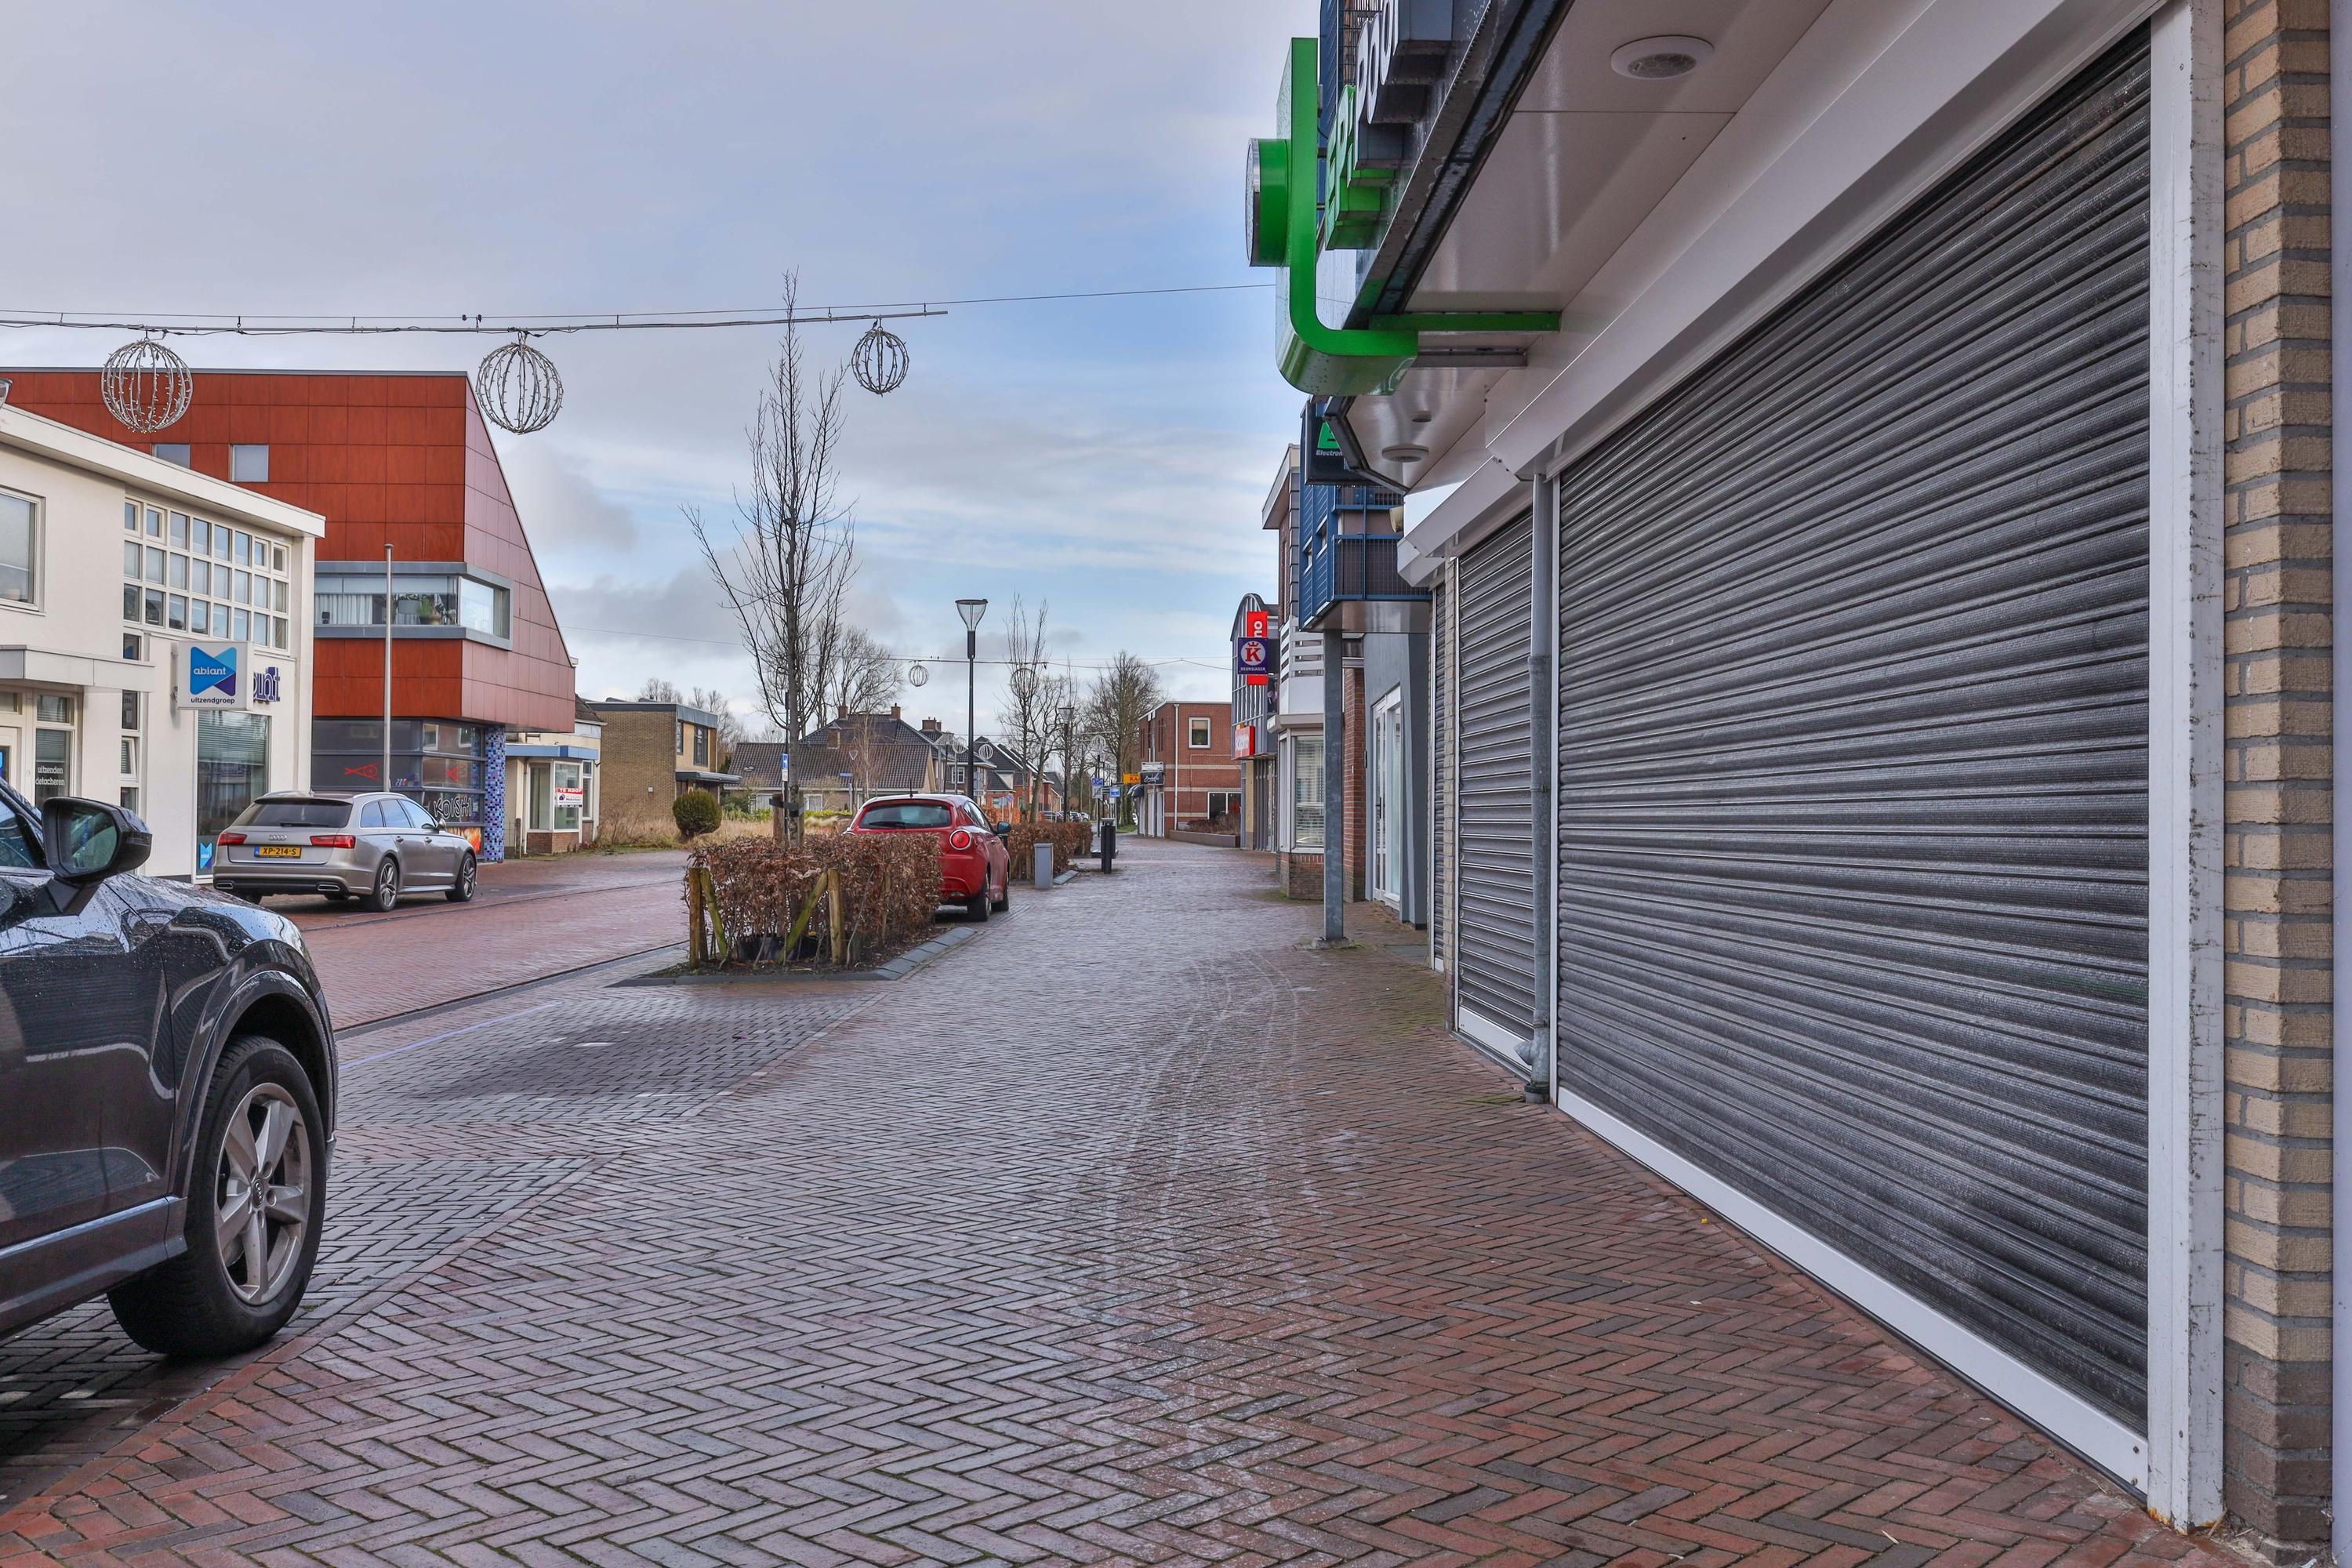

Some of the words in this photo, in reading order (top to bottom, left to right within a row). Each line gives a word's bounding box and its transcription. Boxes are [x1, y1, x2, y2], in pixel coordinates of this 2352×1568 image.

[1245, 648, 1261, 662] K
[193, 666, 227, 675] abiant
[38, 765, 63, 774] uitzenden
[35, 777, 64, 786] detacheren
